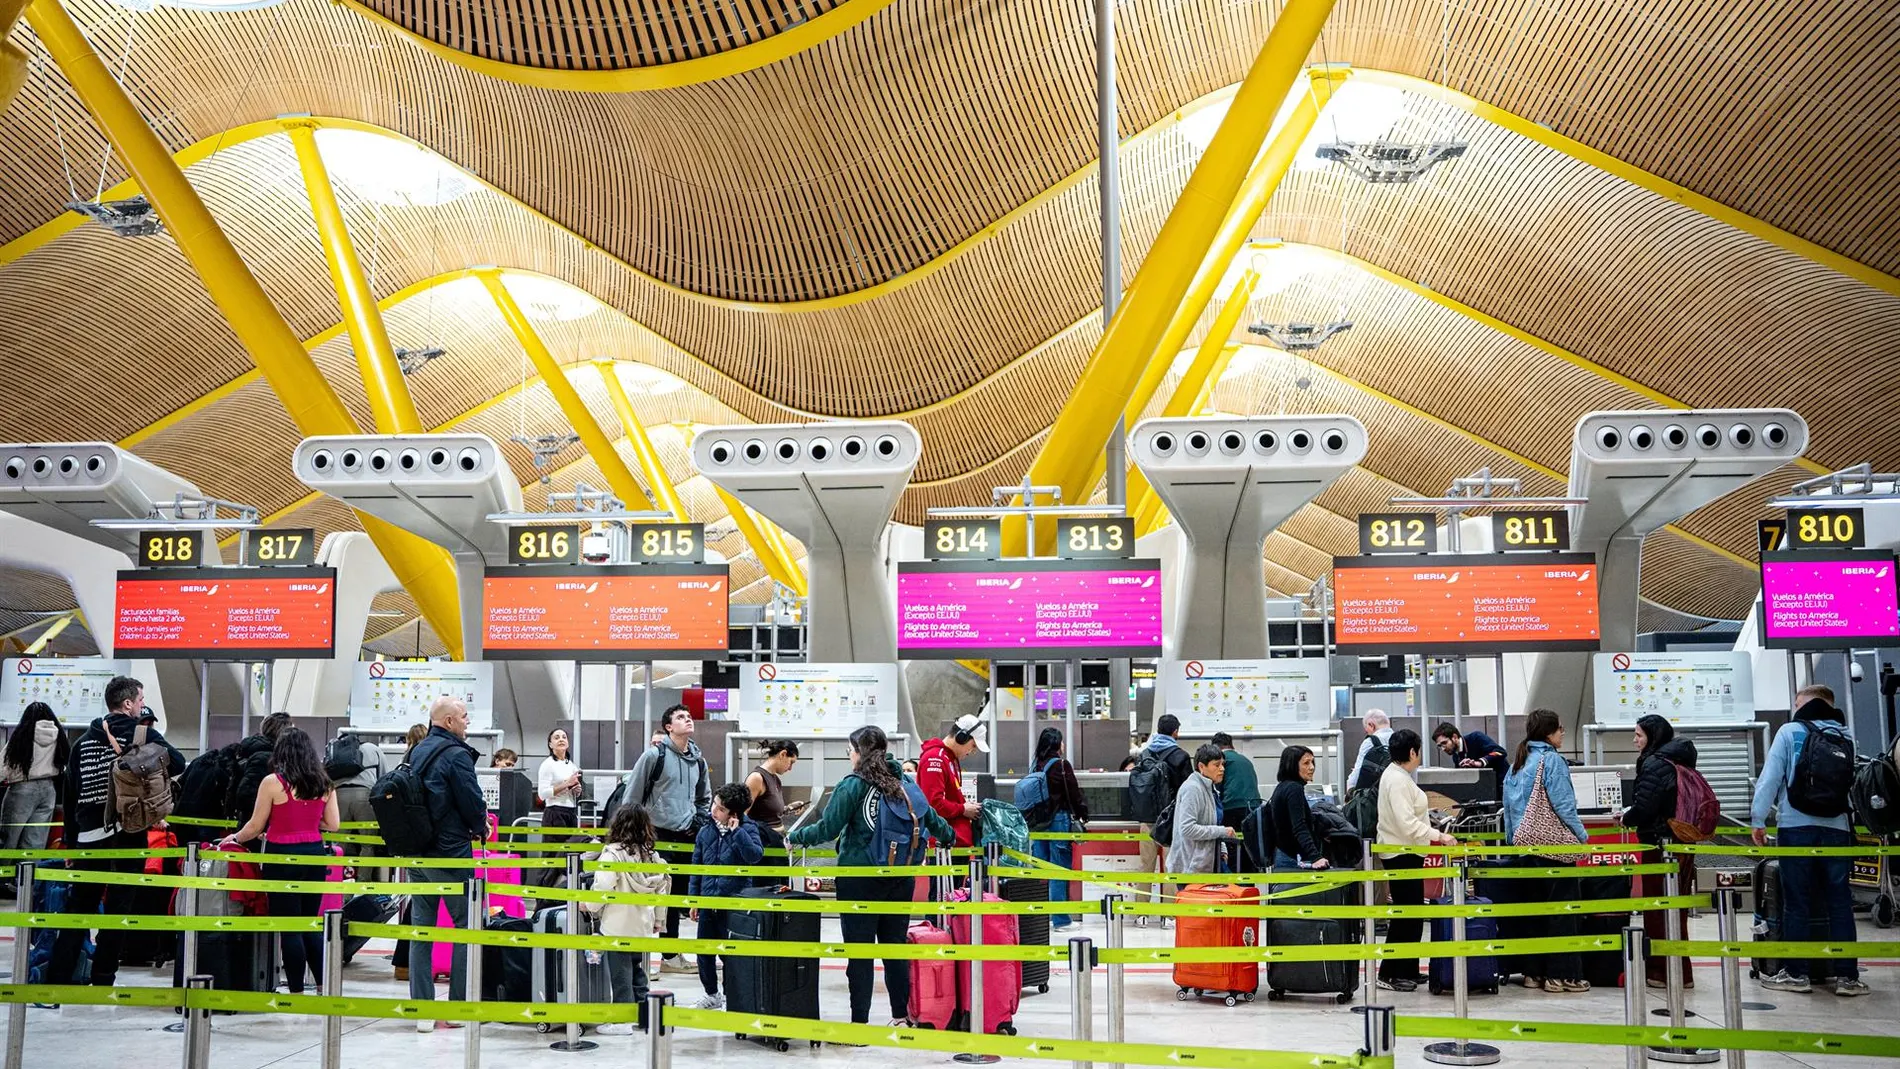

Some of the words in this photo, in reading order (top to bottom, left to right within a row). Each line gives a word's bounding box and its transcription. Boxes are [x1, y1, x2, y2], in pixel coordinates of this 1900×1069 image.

[1505, 517, 1557, 544] 811
[1799, 515, 1853, 542] 810
[1370, 519, 1425, 547] 812
[936, 527, 988, 552] 814
[1069, 525, 1123, 550] 813
[519, 532, 569, 558] 816
[642, 530, 694, 556] 815
[148, 537, 192, 560] 818
[258, 536, 302, 559] 817
[1804, 592, 1834, 600] América
[1036, 602, 1060, 610] Vuelos
[1374, 598, 1404, 606] América
[1773, 601, 1803, 609] (Excepto
[490, 614, 517, 622] (Excepto
[904, 612, 935, 620] (Excepto
[1036, 610, 1067, 618] (Excepto
[1773, 612, 1797, 620] Flights
[1343, 618, 1367, 627] Flights
[1474, 616, 1498, 625] Flights
[1774, 620, 1799, 628] (except
[228, 625, 248, 633] Flights
[489, 625, 511, 633] Flights
[609, 625, 632, 633] Flights
[904, 623, 928, 631] Flights
[1036, 622, 1061, 630] Flights
[1343, 626, 1368, 634] (except
[1475, 624, 1500, 632] (except
[1501, 623, 1524, 631] United
[1526, 623, 1549, 631] States)
[489, 633, 512, 641] (except
[904, 631, 929, 639] (except
[955, 630, 979, 638] States)
[1036, 630, 1061, 638] (except
[1087, 629, 1111, 637] States)
[1423, 858, 1442, 866] RIA
